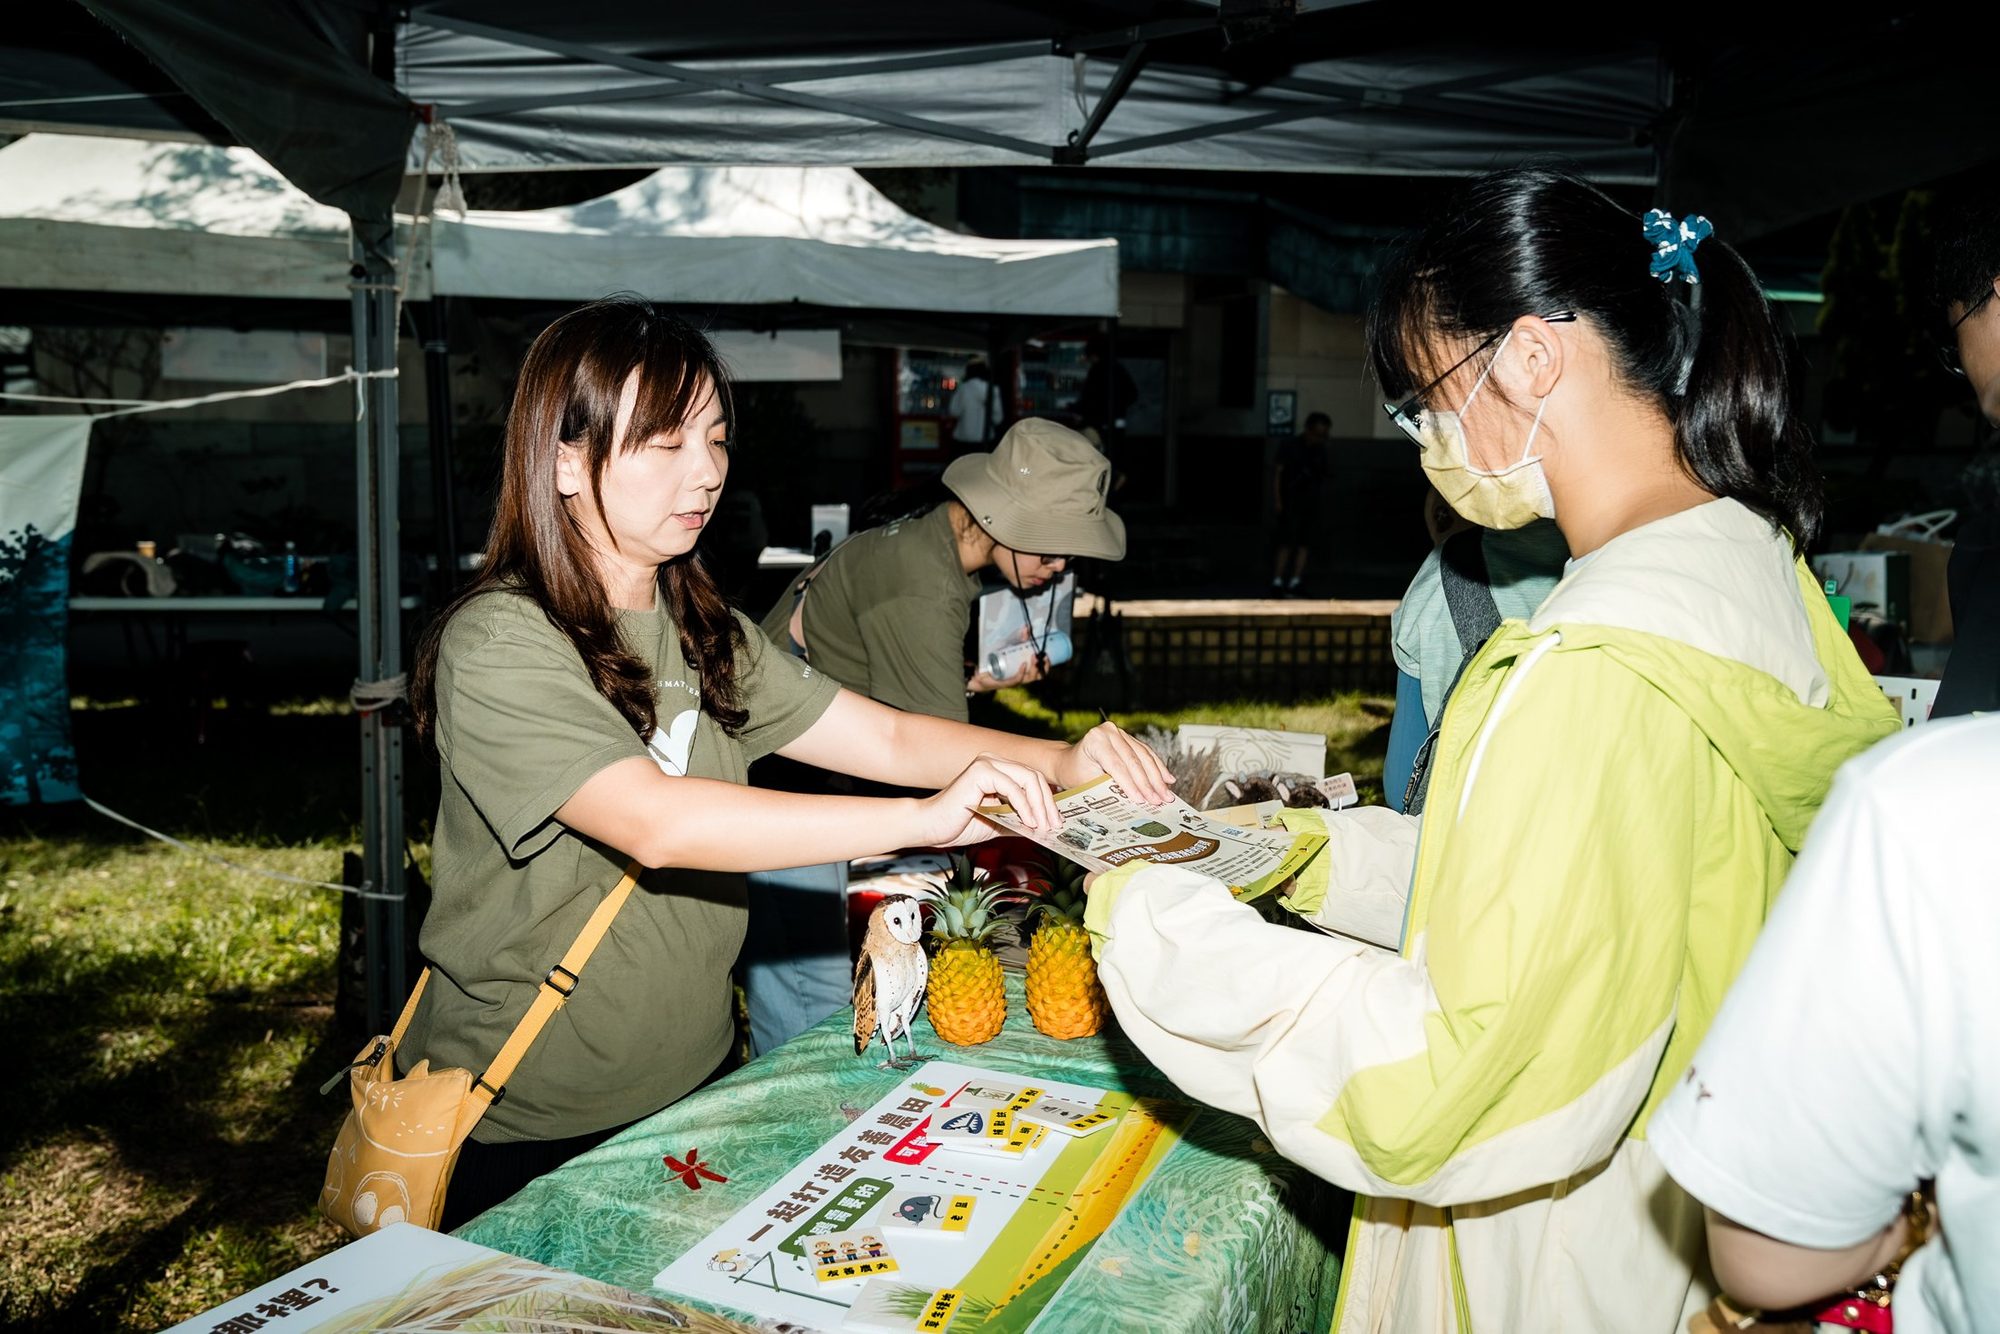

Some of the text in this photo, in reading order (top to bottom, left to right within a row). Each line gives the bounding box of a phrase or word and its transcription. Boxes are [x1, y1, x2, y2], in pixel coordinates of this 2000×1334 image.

[747, 1096, 933, 1243] 一起打造友善農田
